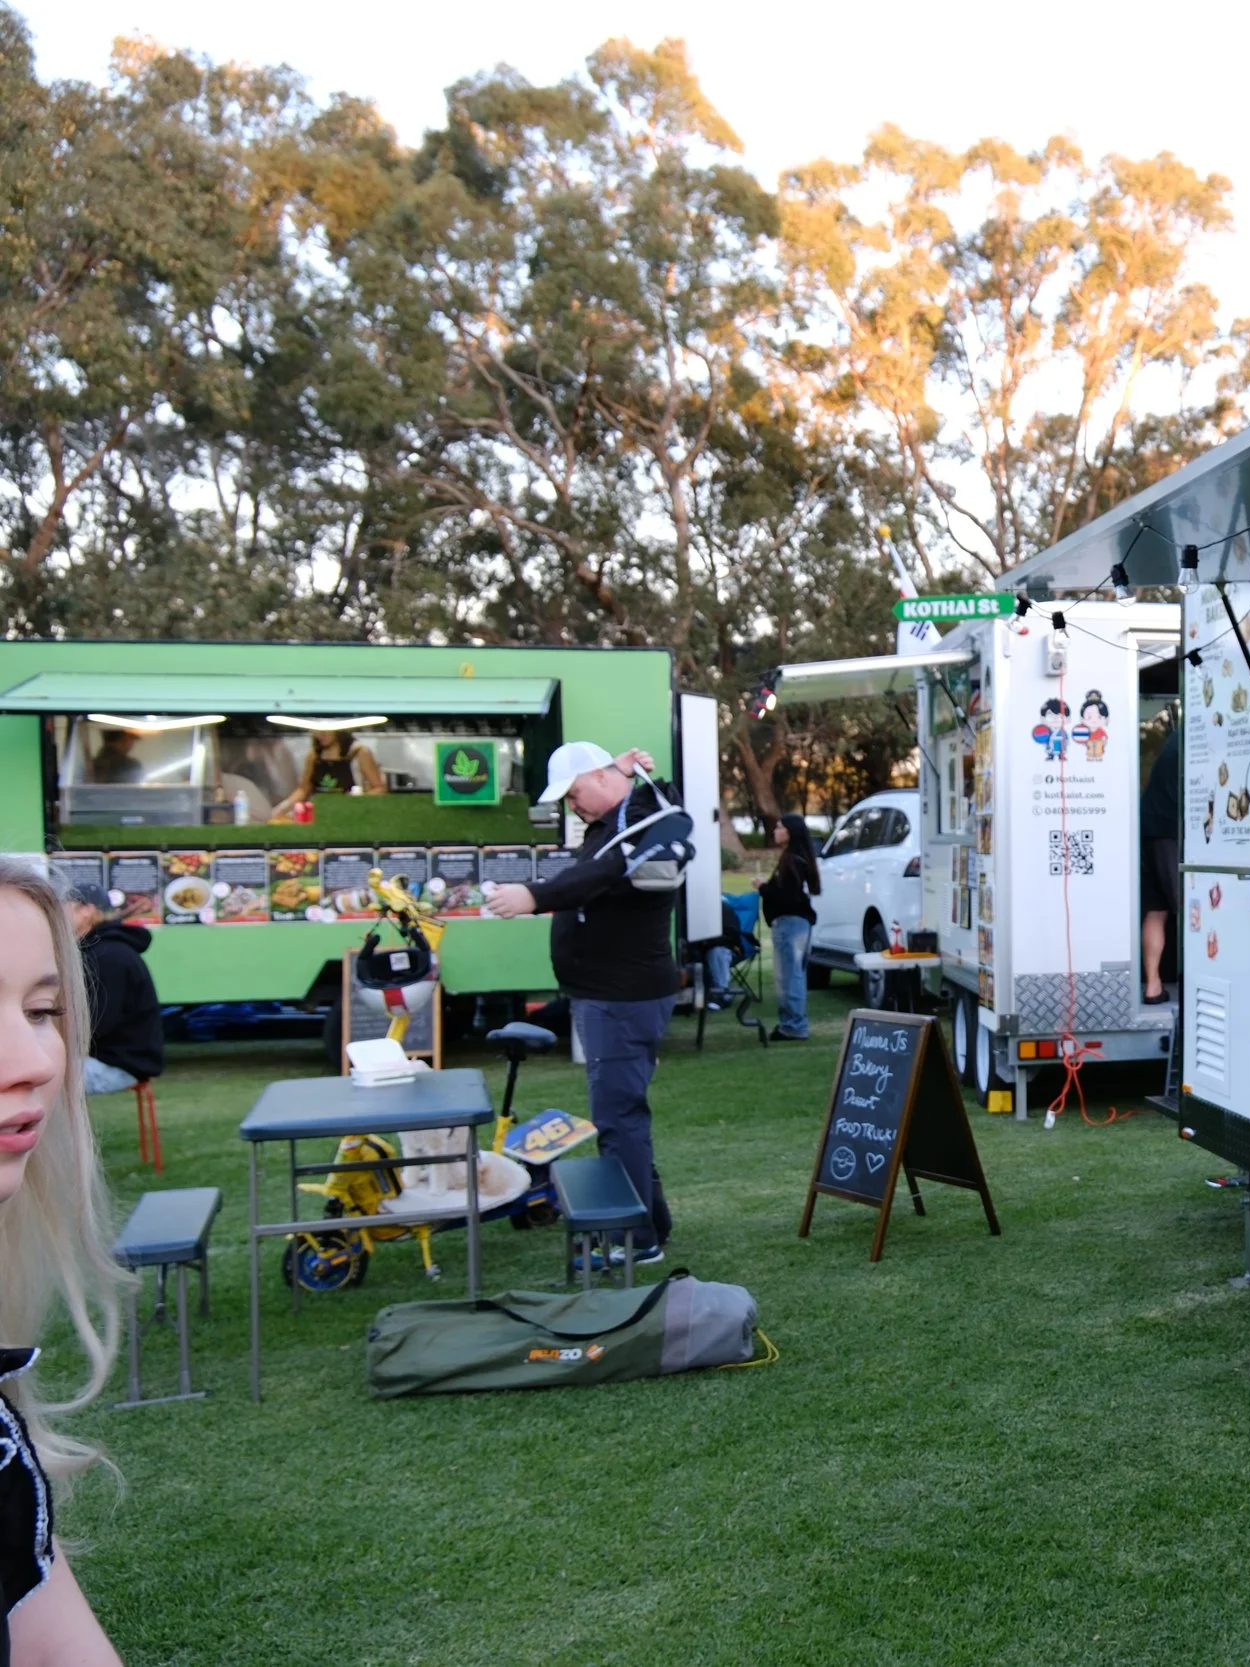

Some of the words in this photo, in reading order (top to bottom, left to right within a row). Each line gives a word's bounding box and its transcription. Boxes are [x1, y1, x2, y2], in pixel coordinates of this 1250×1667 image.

[902, 599, 976, 618] KOTHAI
[977, 598, 1000, 614] St
[850, 1053, 894, 1094] Bakery
[524, 1116, 571, 1151] 46
